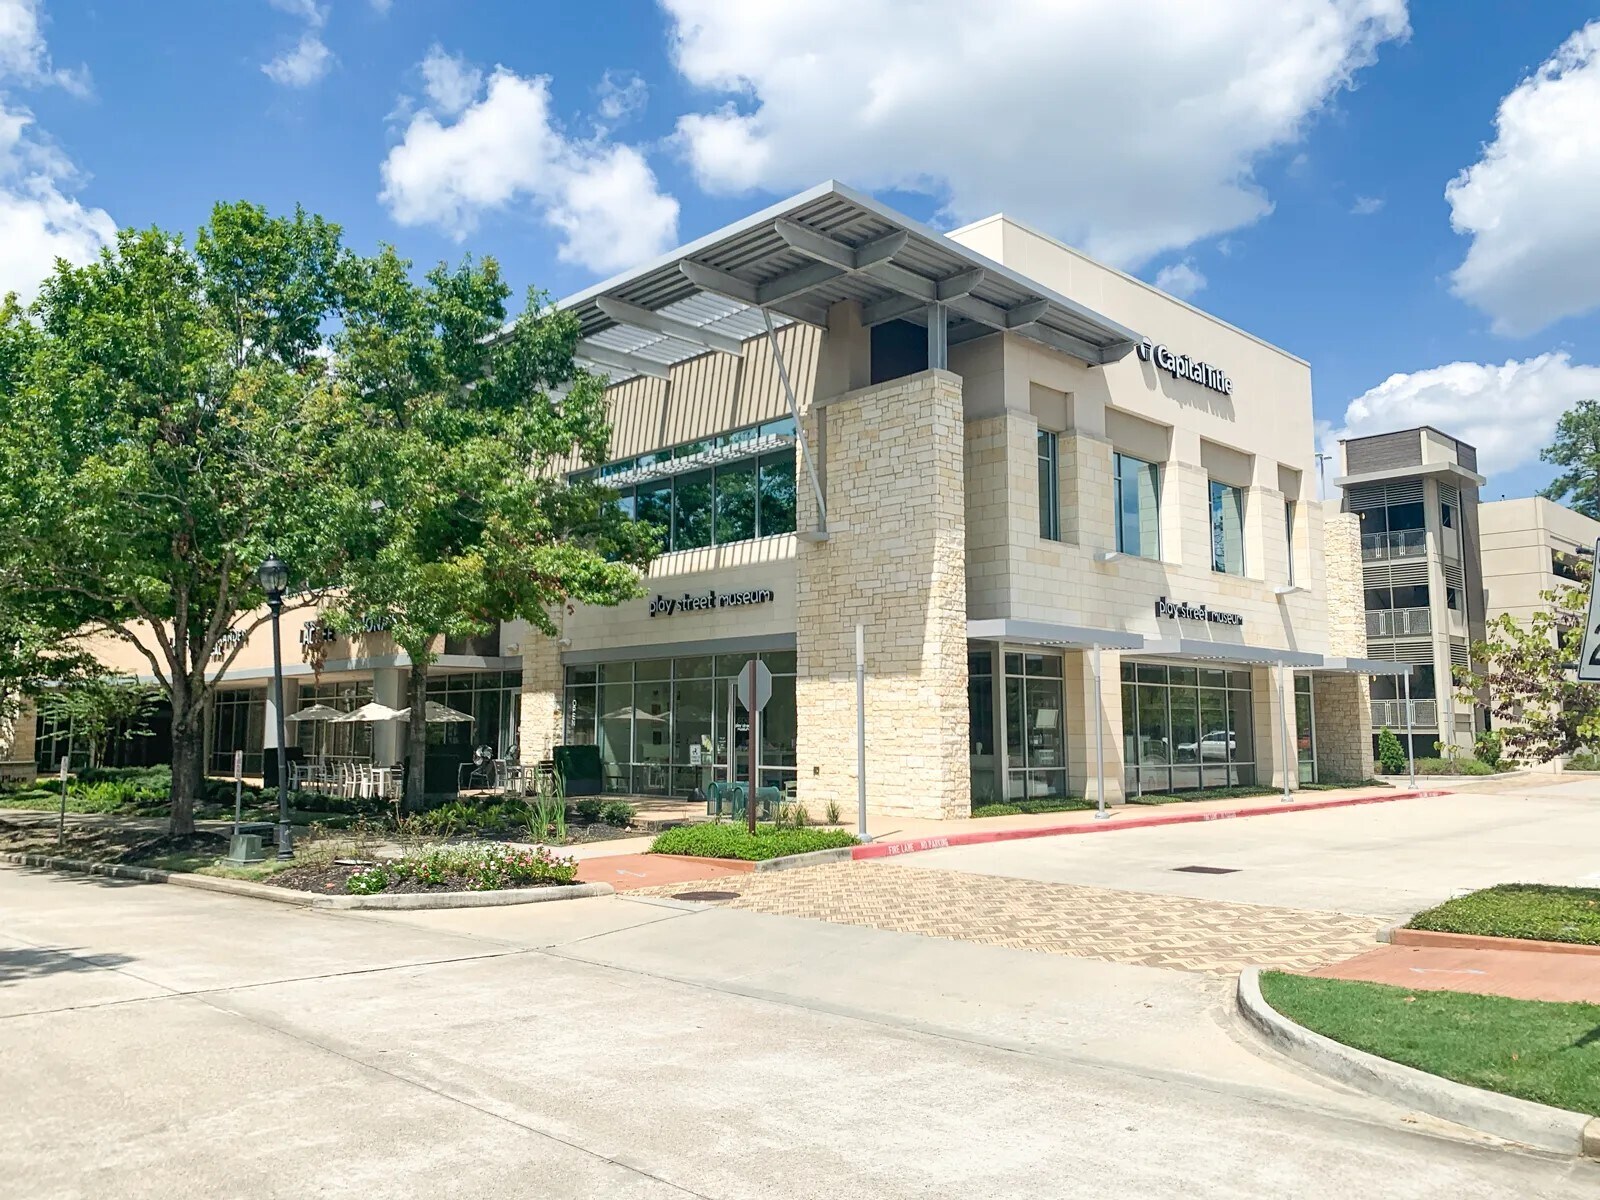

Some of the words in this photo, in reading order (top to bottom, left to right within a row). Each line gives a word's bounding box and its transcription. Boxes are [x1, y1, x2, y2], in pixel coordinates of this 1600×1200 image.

[649, 595, 675, 617] play
[676, 590, 716, 611] street
[718, 589, 774, 607] museum
[1155, 596, 1178, 619] play
[1209, 611, 1243, 625] museum
[1, 774, 27, 783] Place
